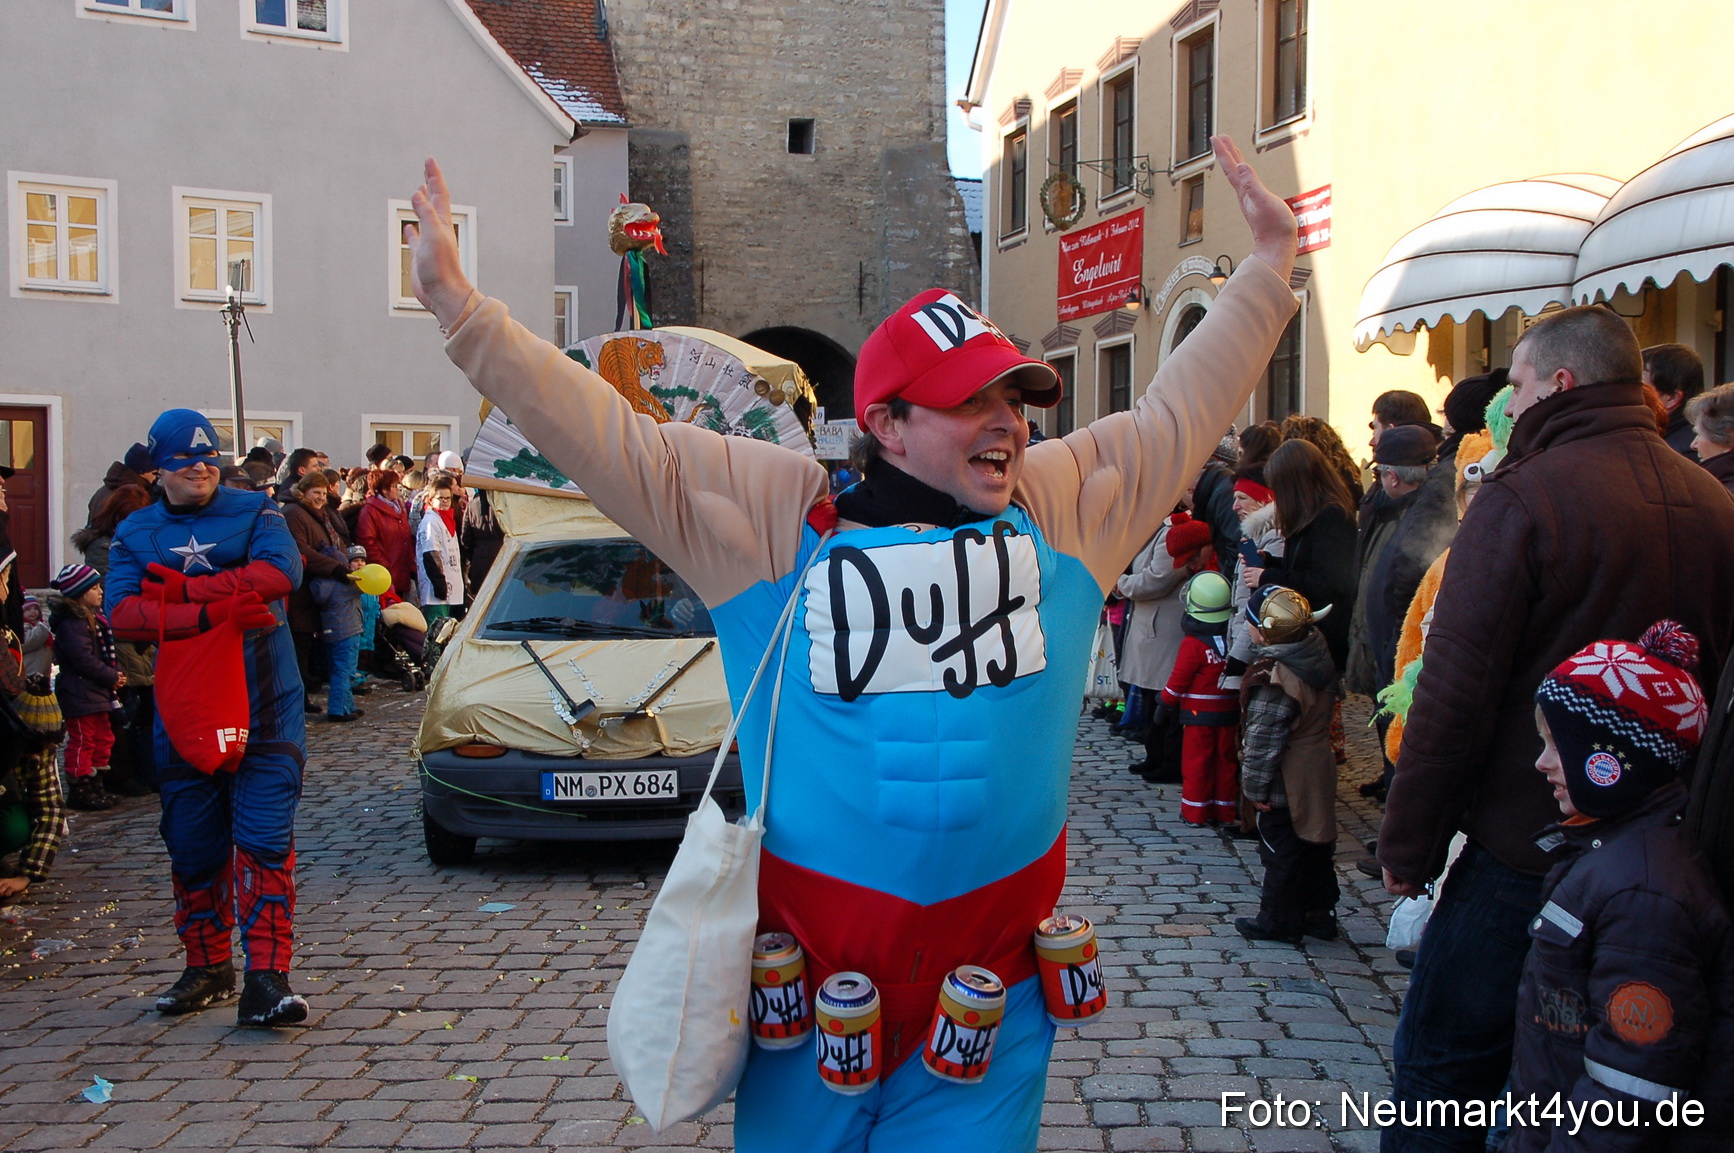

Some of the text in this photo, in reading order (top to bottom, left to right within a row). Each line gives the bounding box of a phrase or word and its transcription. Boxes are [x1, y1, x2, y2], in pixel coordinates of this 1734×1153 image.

[1073, 252, 1122, 289] Engelwirt
[190, 427, 212, 448] A
[829, 520, 1026, 702] Duff
[554, 775, 583, 797] NM
[599, 775, 628, 797] PX
[633, 773, 675, 796] 684
[751, 976, 804, 1025] Duff
[817, 1025, 868, 1075] Duff
[934, 1014, 997, 1069] Duff
